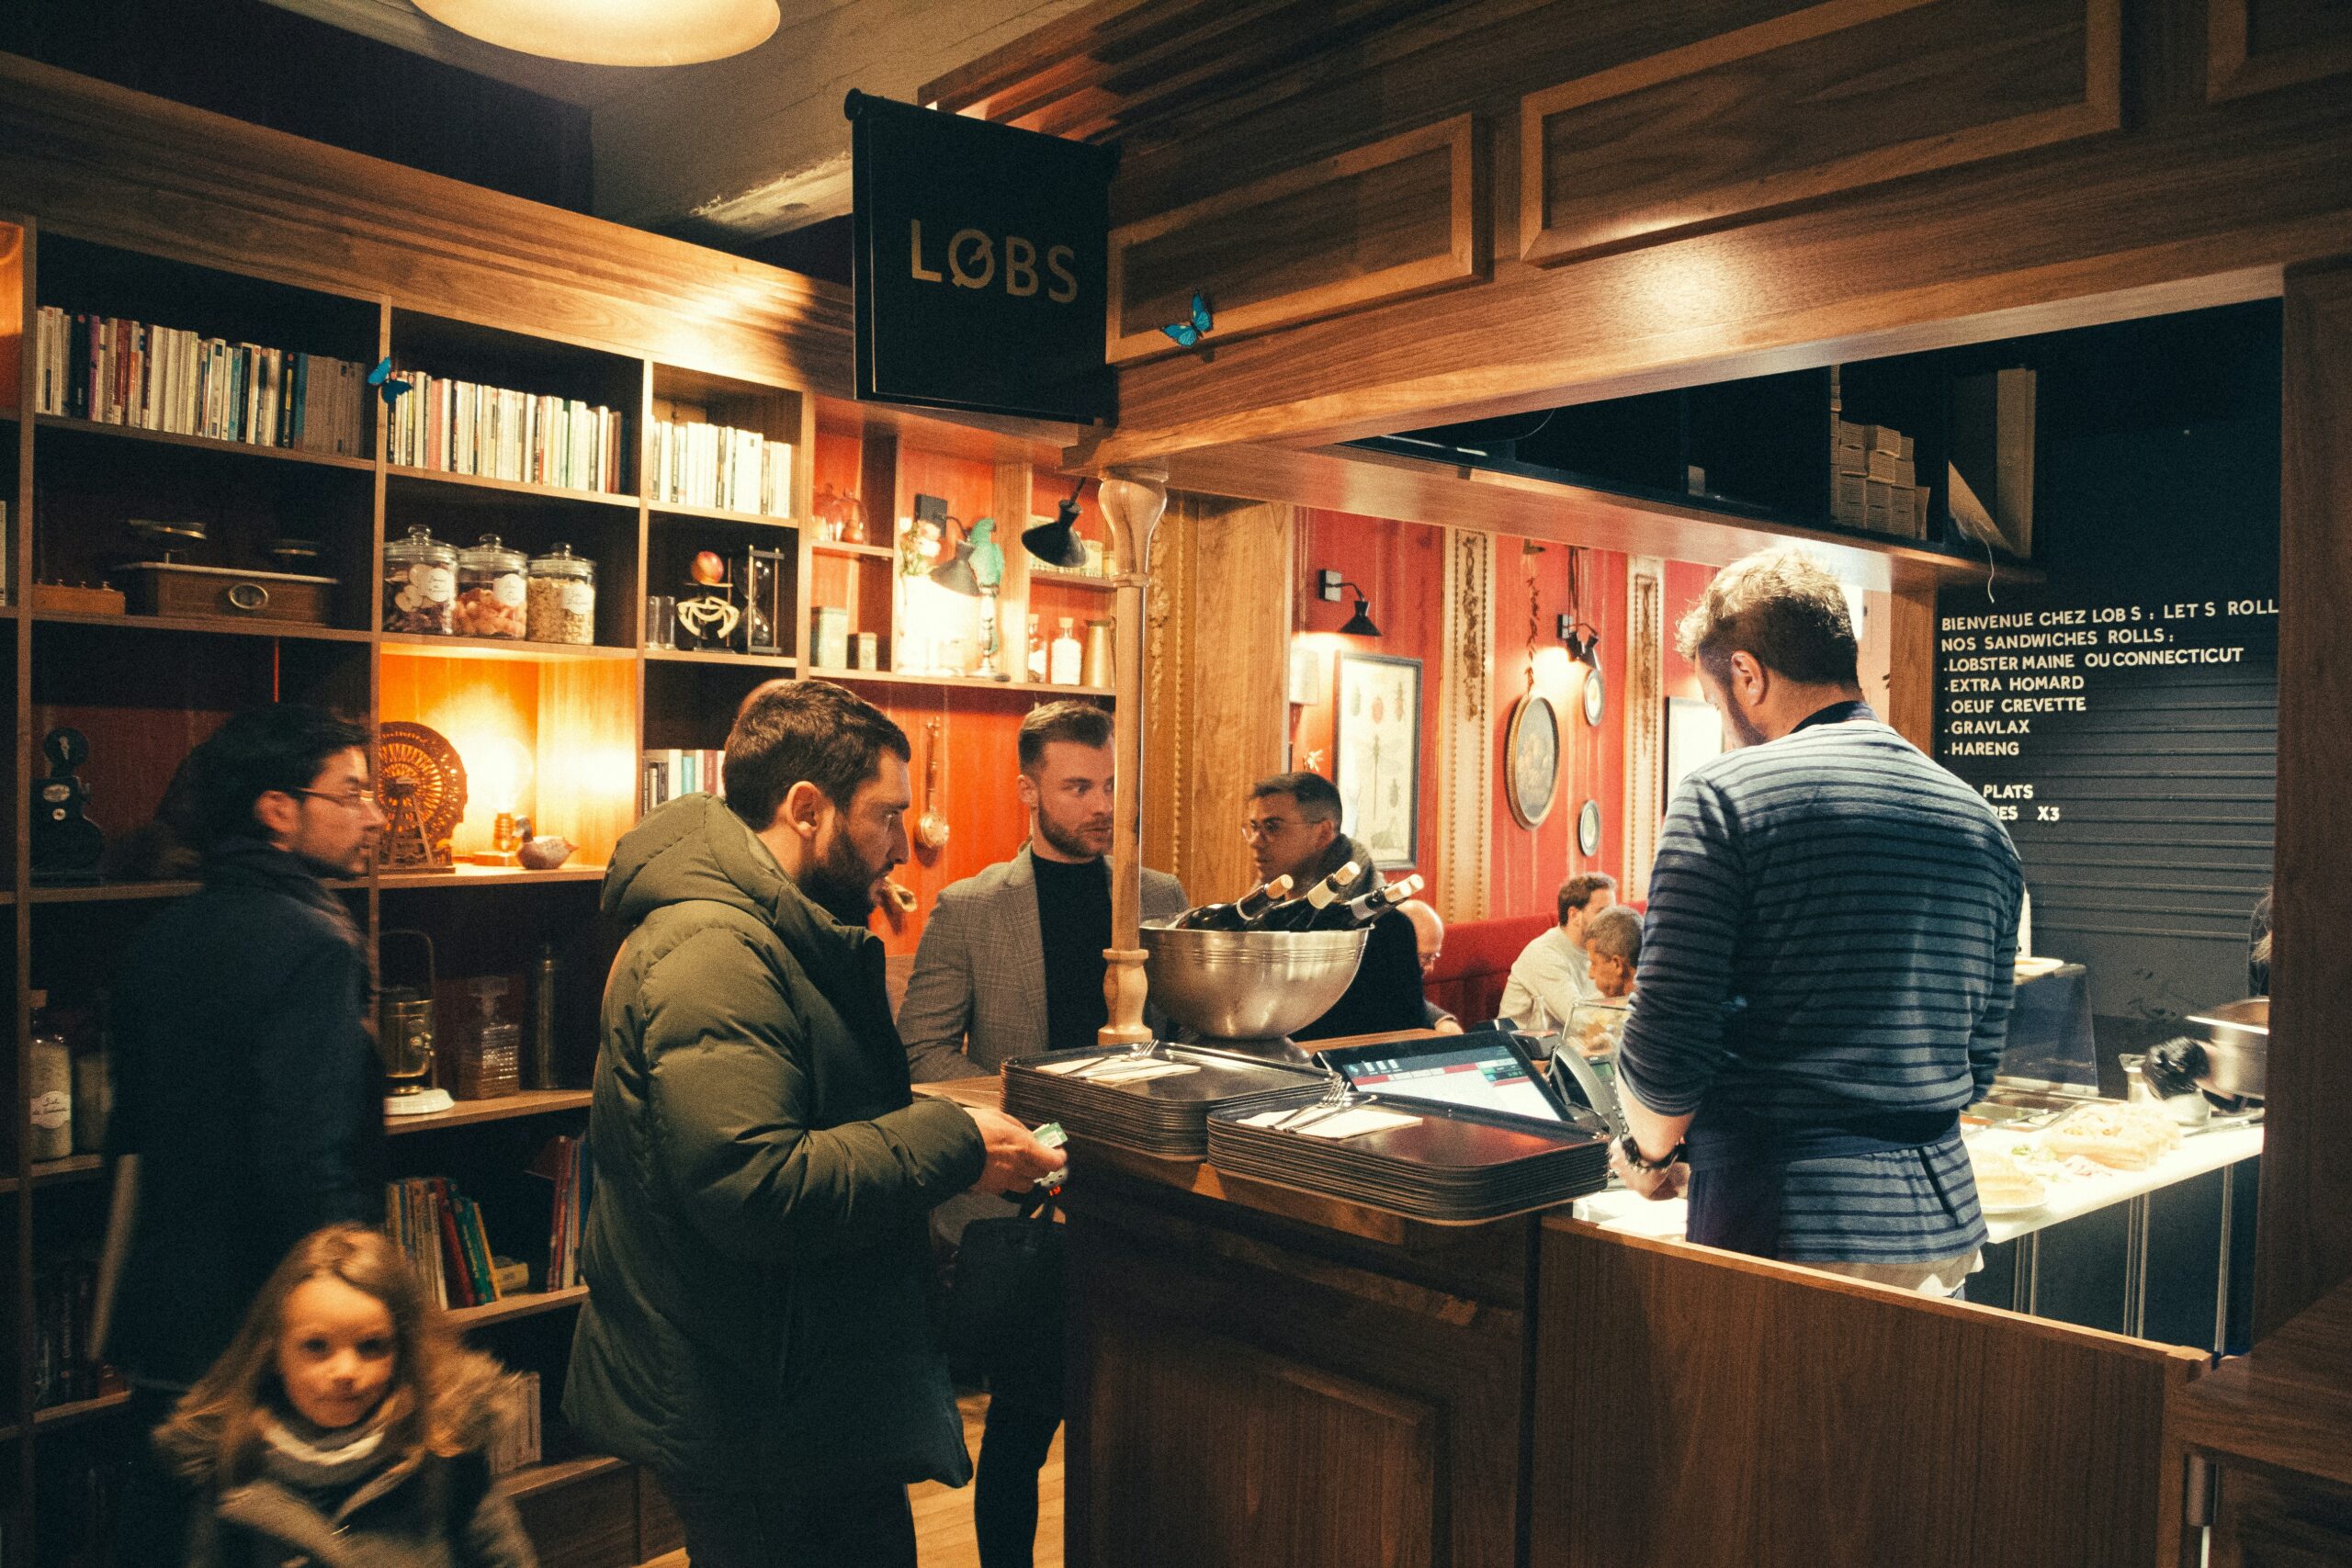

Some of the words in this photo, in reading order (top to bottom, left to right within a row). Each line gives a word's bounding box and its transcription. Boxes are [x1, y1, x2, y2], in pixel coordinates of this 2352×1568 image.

[1941, 613, 2033, 631] BIENVENUE
[2039, 610, 2086, 626] CHEZ
[2227, 599, 2278, 615] ROLL
[1941, 637, 1976, 652] NOS
[1984, 630, 2098, 650] SANDWICHES
[2022, 654, 2075, 670] MAINE
[2112, 648, 2245, 666] CONNECTICUT
[2009, 675, 2085, 691] HOMARD
[2001, 697, 2086, 713] CREVETTE
[1983, 784, 2033, 799] PLATS
[2037, 806, 2060, 821] X3
